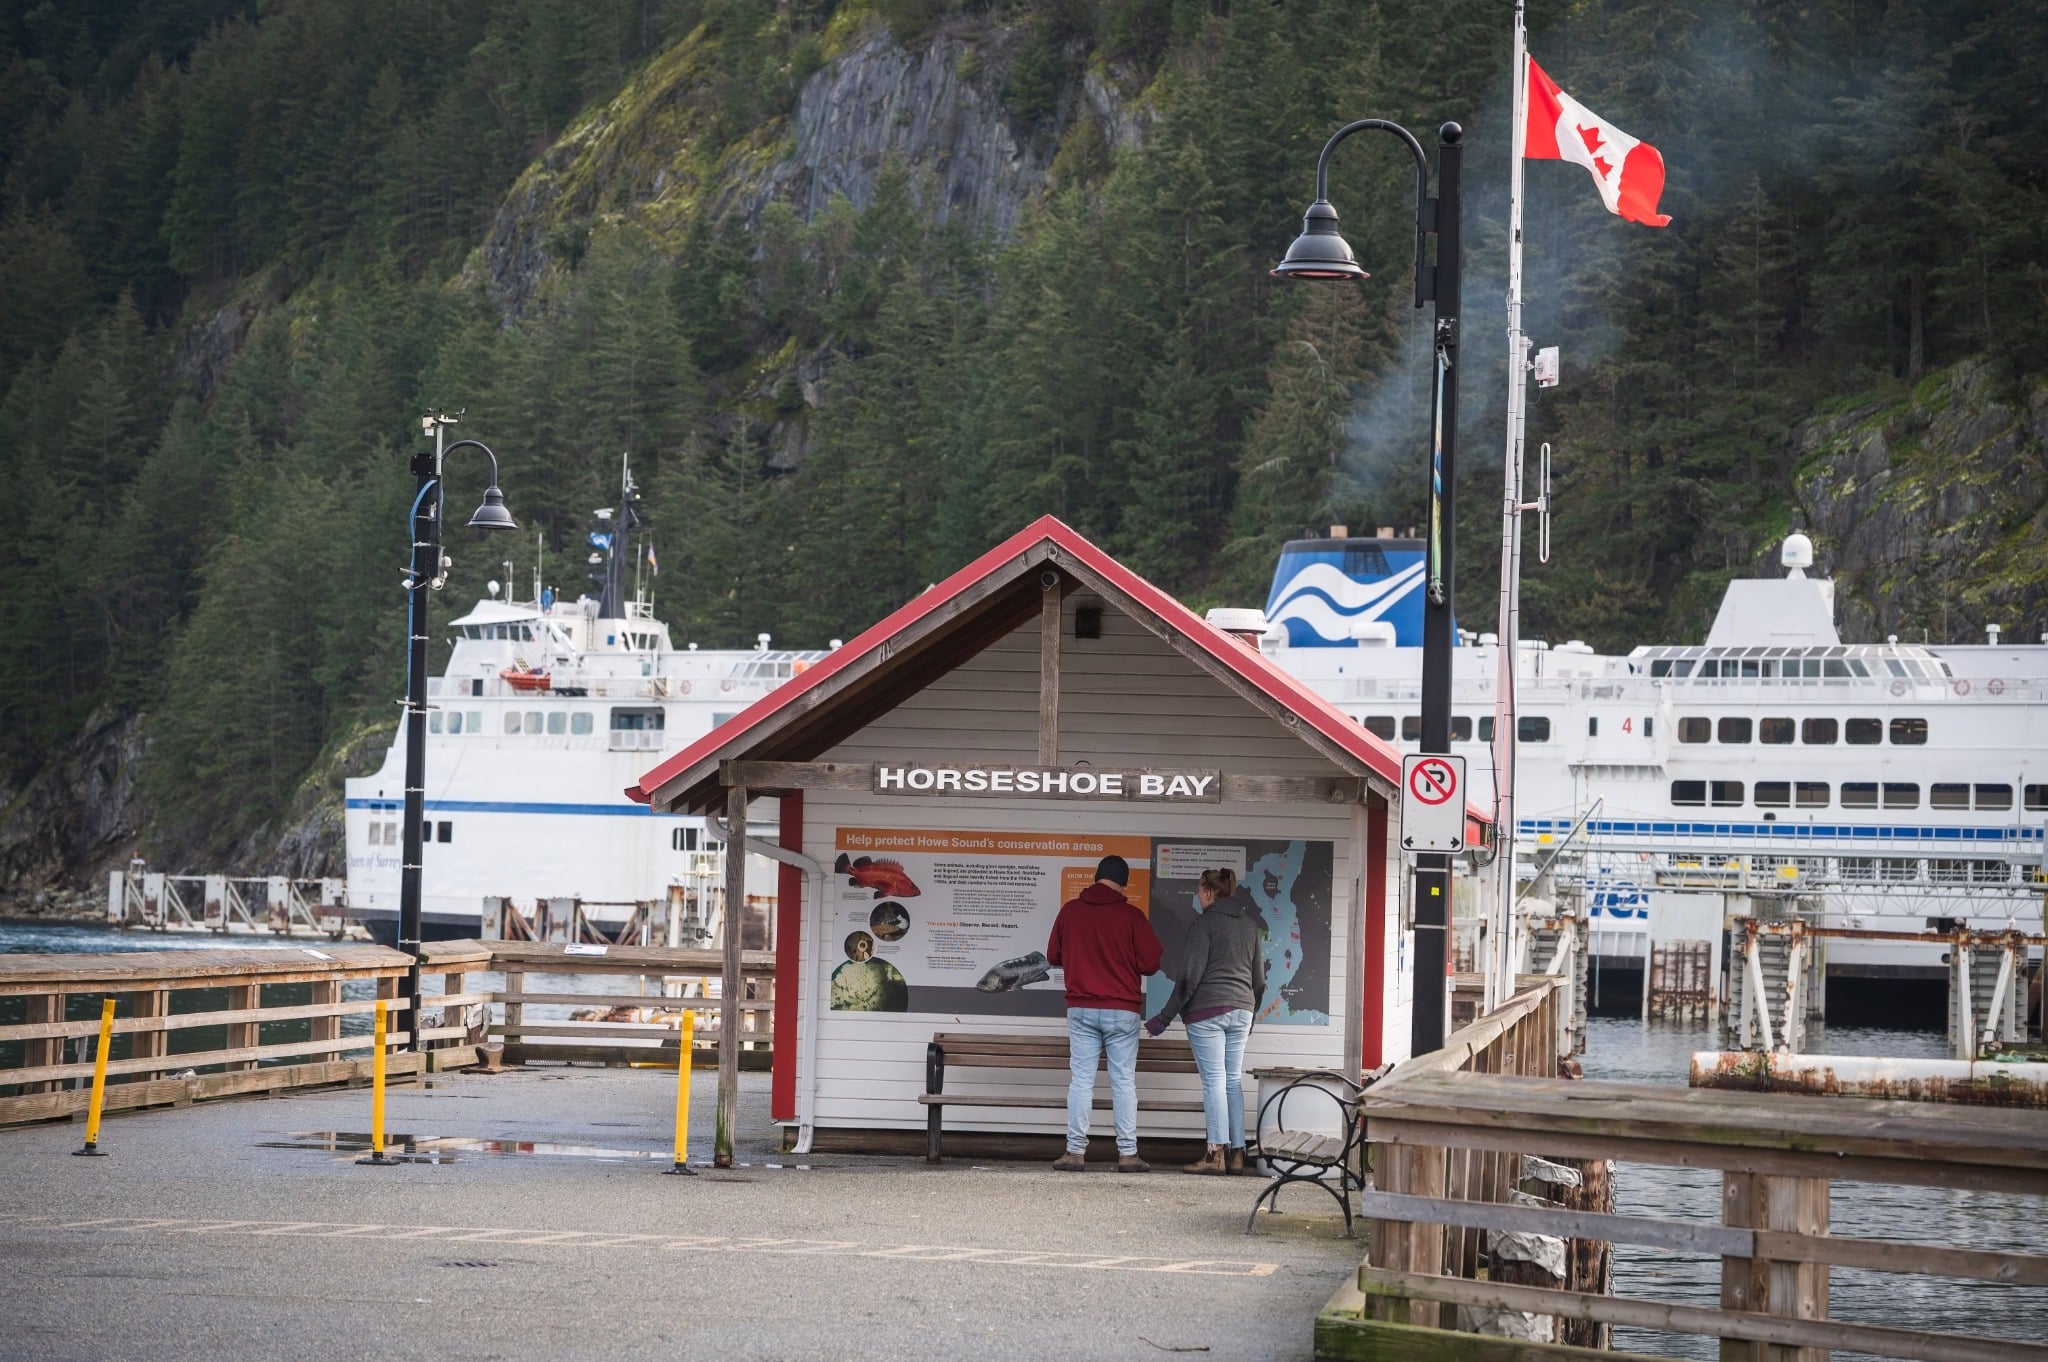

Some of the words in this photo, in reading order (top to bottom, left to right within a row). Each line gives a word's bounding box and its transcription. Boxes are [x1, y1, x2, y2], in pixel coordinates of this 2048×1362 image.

[1622, 716, 1632, 734] 4
[880, 768, 1122, 794] HORSESHOE
[1140, 774, 1214, 796] BAY
[846, 834, 872, 847] Help
[875, 836, 914, 848] protect
[918, 836, 948, 847] Howe
[952, 838, 994, 848] Sound's
[998, 840, 1070, 850] conservation
[1072, 842, 1104, 851] areas
